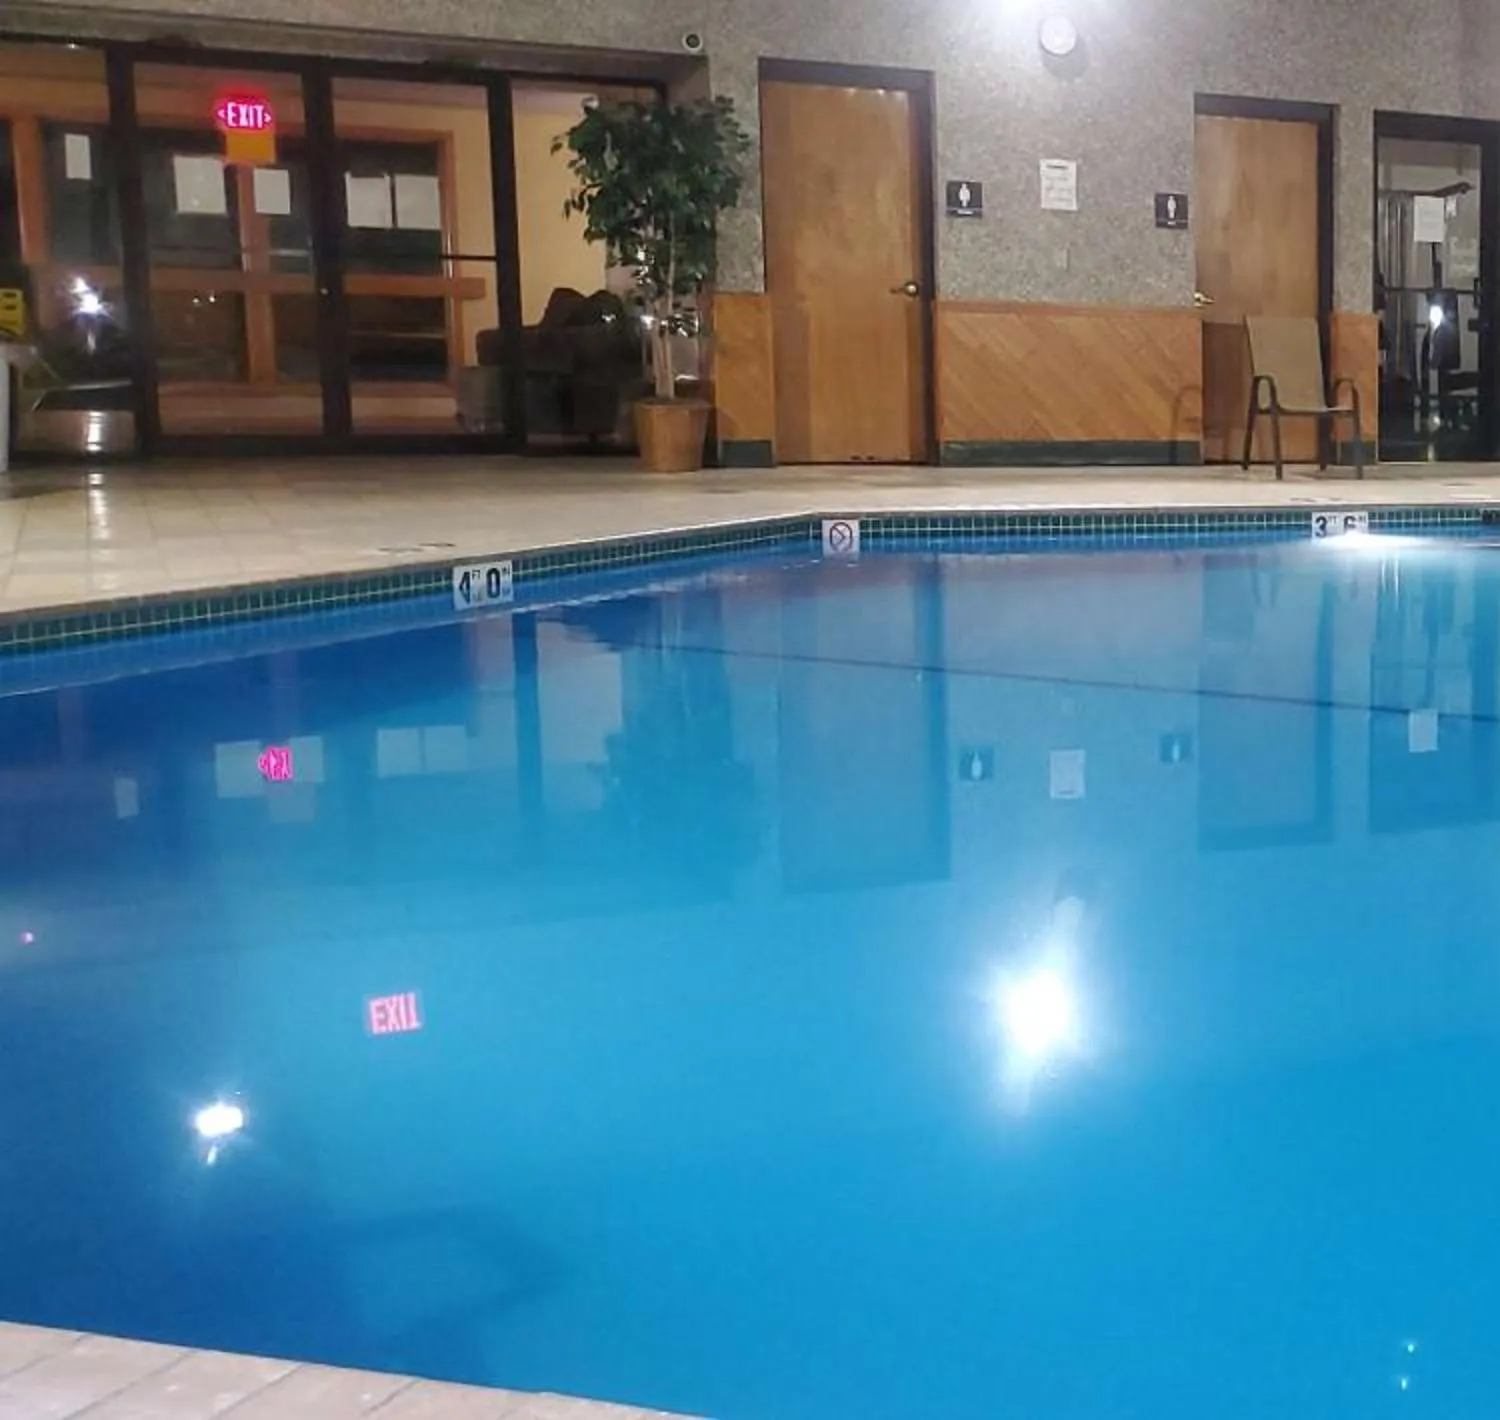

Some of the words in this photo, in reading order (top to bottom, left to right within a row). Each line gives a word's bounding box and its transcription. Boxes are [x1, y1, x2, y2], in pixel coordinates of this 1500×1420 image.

[227, 102, 264, 129] EXIT
[1316, 516, 1327, 538] 3
[459, 571, 470, 605] 4
[486, 568, 500, 599] 0
